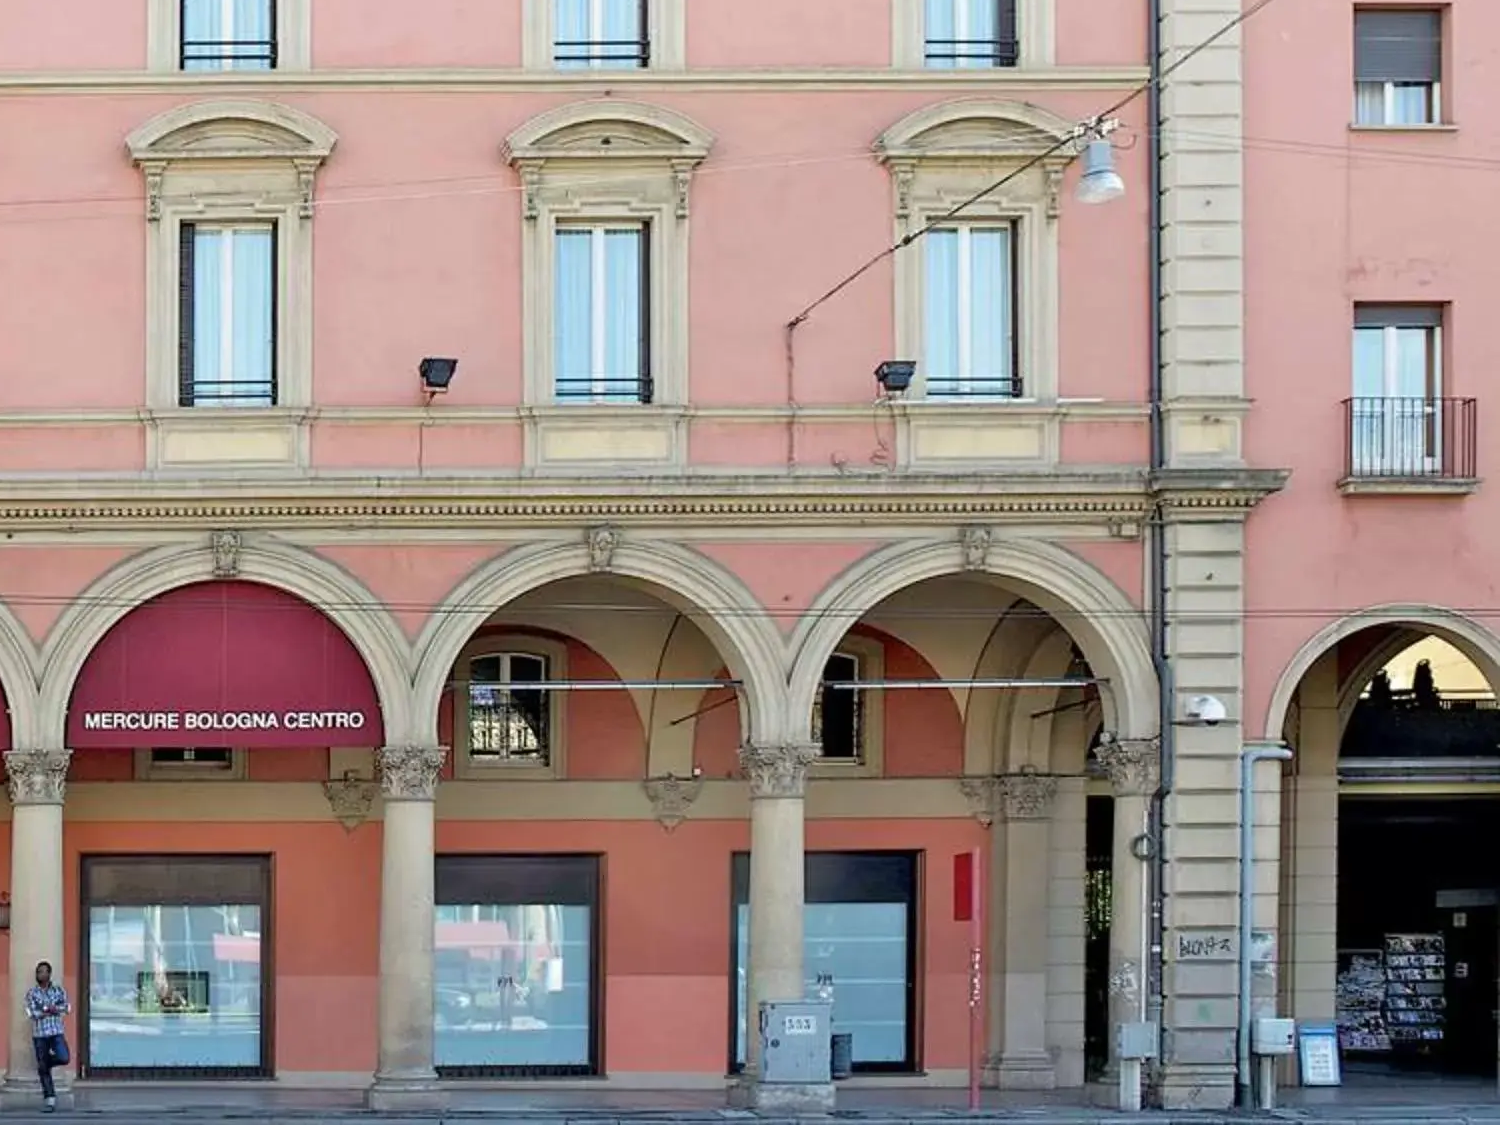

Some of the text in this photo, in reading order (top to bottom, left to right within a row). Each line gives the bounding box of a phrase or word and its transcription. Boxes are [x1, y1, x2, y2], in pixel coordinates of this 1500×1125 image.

[85, 712, 365, 729] MERCURE BOLOGNA CENTRO
